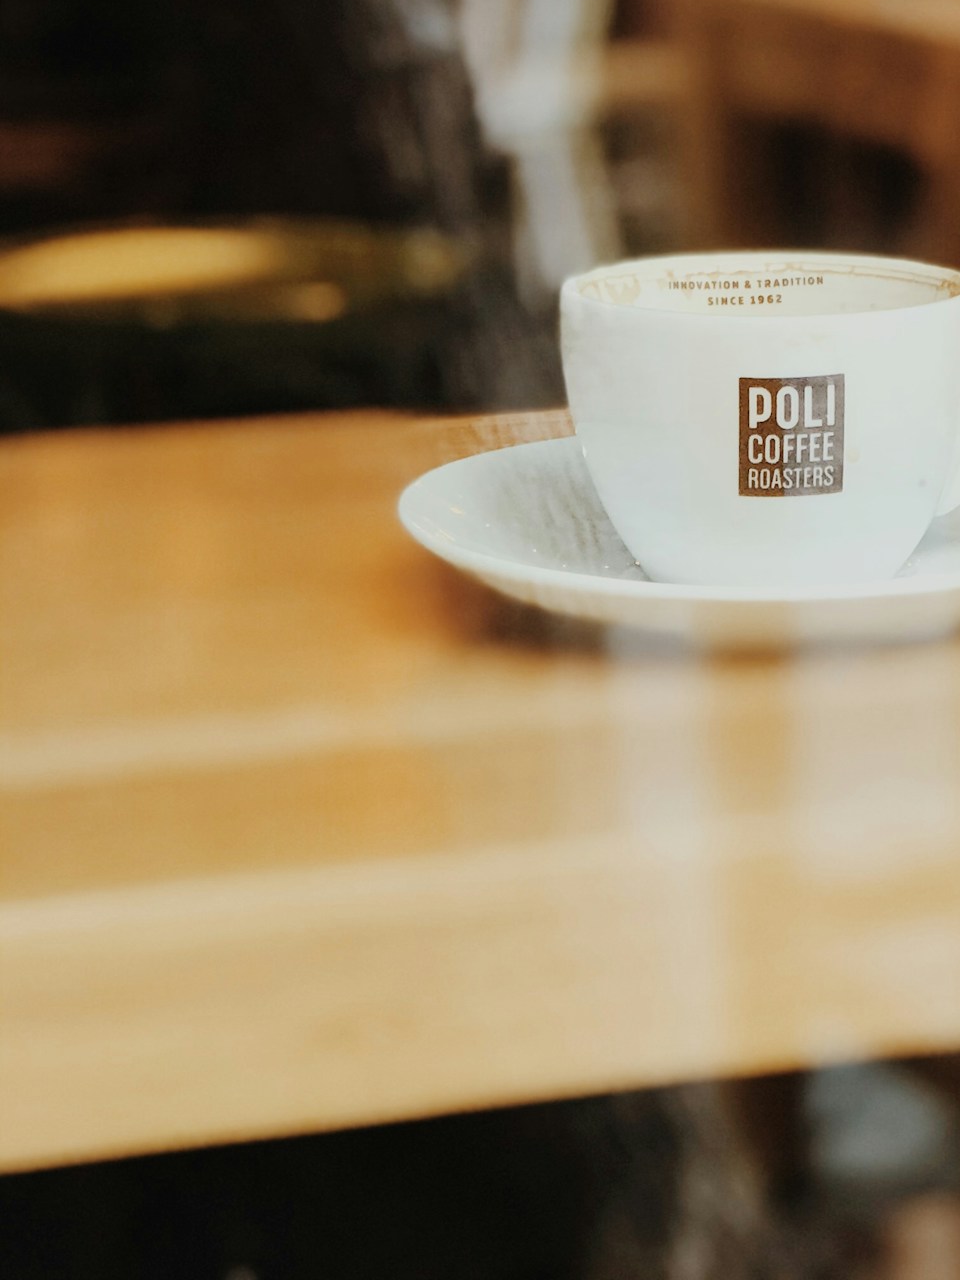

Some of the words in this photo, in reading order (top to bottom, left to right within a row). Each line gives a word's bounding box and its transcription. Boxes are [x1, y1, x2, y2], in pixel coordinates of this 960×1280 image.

[668, 280, 740, 290] INNOVATION
[744, 279, 752, 289] &
[757, 275, 824, 288] TRADITION
[707, 296, 745, 306] SINCE
[750, 294, 783, 305] 1962
[748, 384, 835, 430] POLI
[748, 431, 834, 464] COFFEE
[748, 465, 834, 489] ROASTERS
